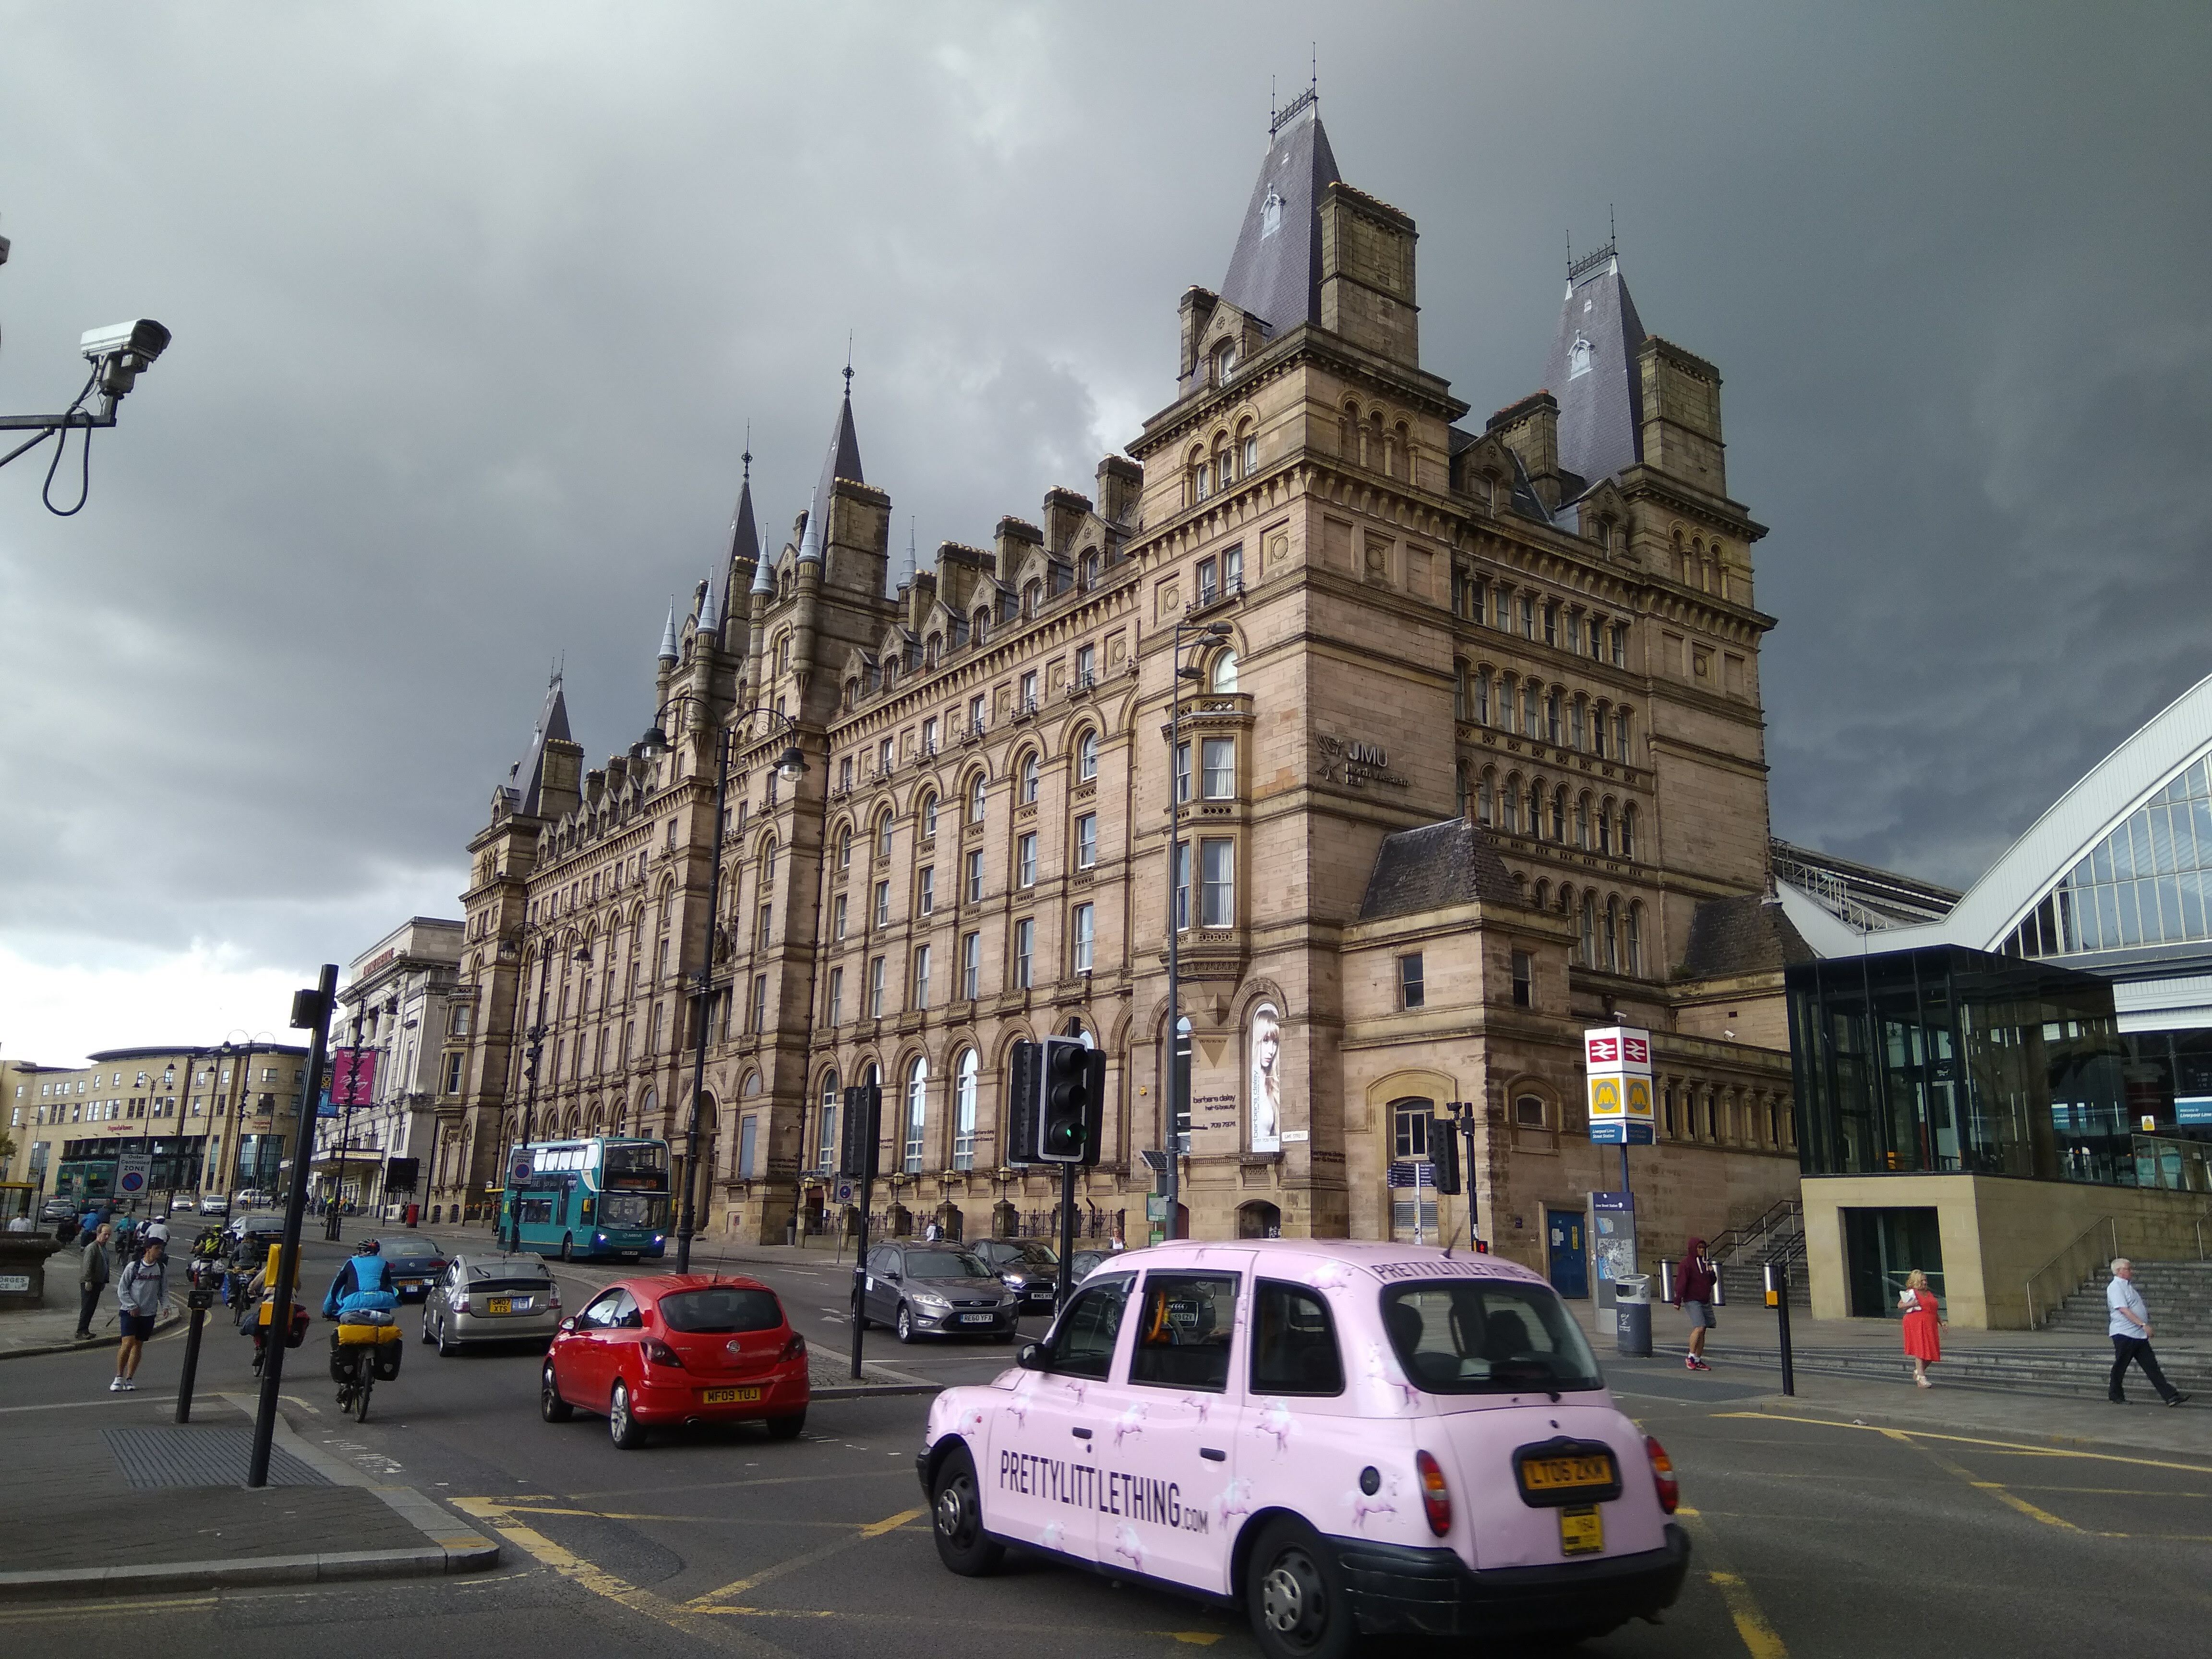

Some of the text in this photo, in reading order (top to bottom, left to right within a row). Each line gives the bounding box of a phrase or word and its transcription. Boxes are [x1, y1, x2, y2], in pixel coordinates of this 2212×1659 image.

[1348, 742, 1388, 767] JMU
[1345, 762, 1409, 787] North Western
[1345, 774, 1364, 787] Hall
[708, 1389, 757, 1402] MF09 TUJ
